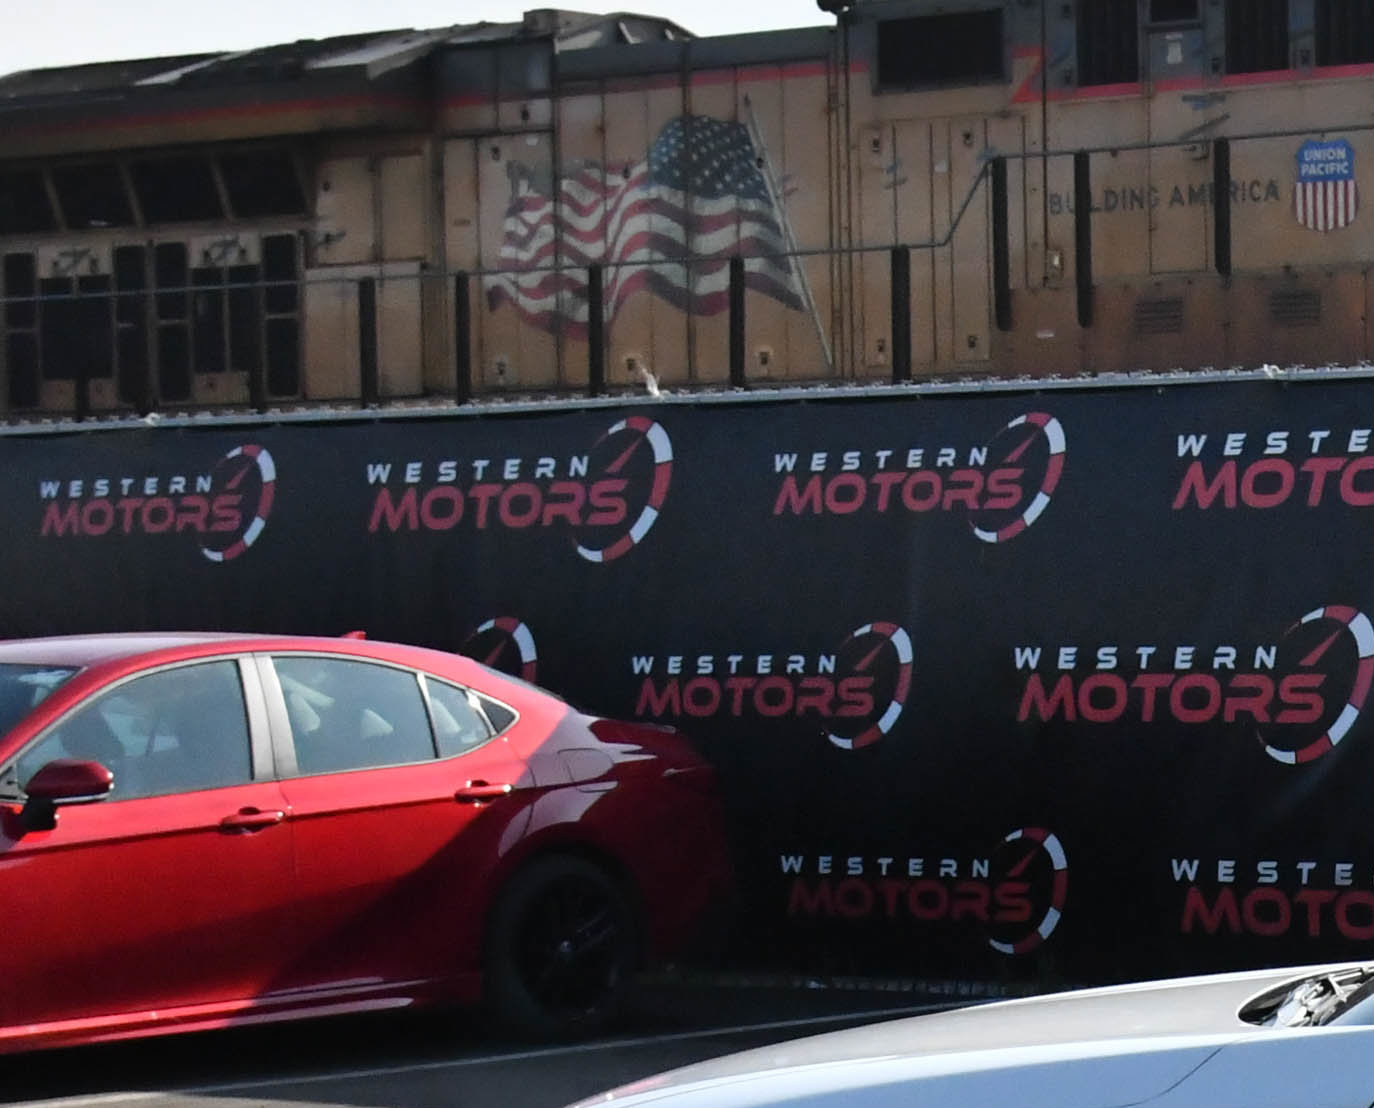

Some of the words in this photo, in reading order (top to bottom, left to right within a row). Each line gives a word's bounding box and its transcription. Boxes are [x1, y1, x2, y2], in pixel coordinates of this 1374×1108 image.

[1301, 161, 1349, 176] PACIFIC
[1303, 147, 1346, 162] UNION
[1049, 186, 1161, 215] BUDING
[1168, 178, 1280, 208] AMRICA
[367, 455, 589, 485] WESTERN
[774, 446, 988, 473] WESTERN
[40, 475, 212, 499] WESTERN
[774, 466, 1024, 515] MOTORS
[42, 494, 242, 536] MOTORS
[369, 478, 628, 533] MOTORS
[632, 654, 836, 675] WESTERN
[1014, 645, 1278, 670] WESTERN
[636, 676, 874, 717] MOTORS
[1017, 672, 1326, 724] MOTORS
[781, 855, 989, 878] WESTERN
[787, 876, 1032, 921] MOTORS
